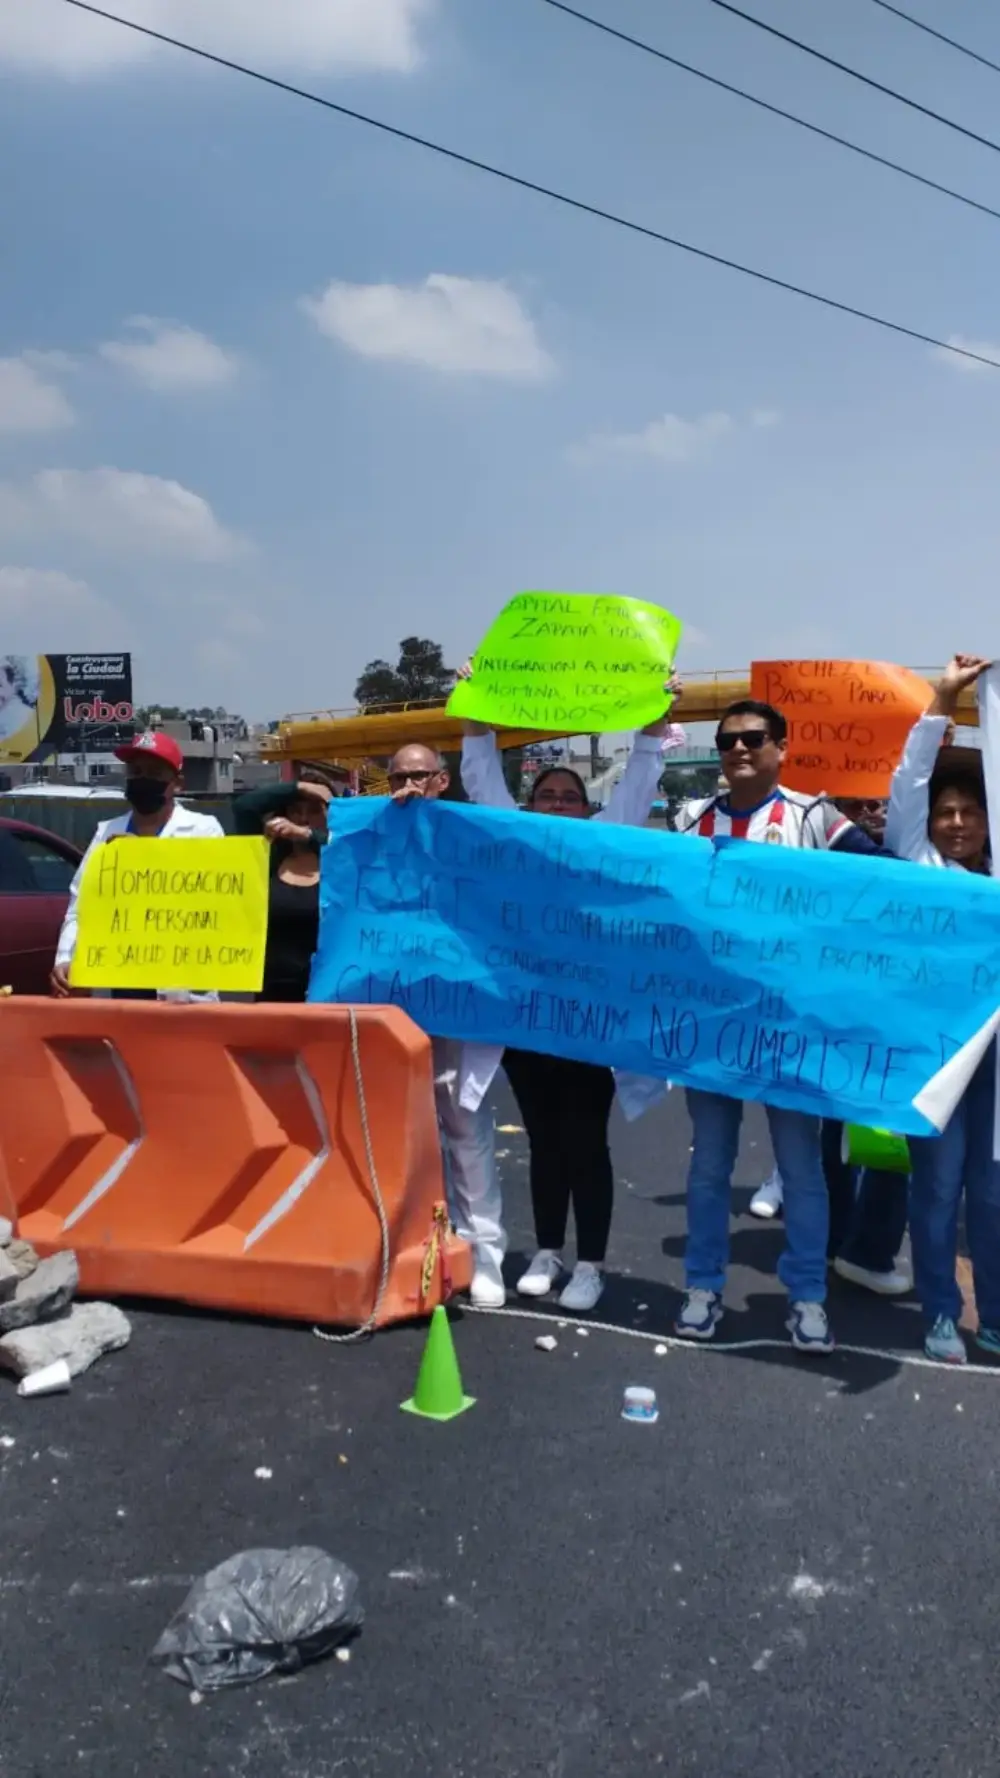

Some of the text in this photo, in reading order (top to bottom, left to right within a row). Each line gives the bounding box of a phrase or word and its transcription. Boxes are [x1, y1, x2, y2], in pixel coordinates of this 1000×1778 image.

[509, 617, 598, 639] ZAPATA
[82, 662, 123, 673] Ciudad
[478, 656, 575, 673] INTEGRACION
[584, 660, 598, 673] A
[787, 719, 875, 747] TODOS
[98, 849, 245, 900] HOMOLOGACION
[704, 853, 833, 920] EMILIANO
[843, 874, 957, 935] ZAPATA
[110, 907, 222, 934] AL PERSONAL
[86, 945, 107, 968] DE
[116, 943, 165, 967] SALUD
[172, 945, 189, 967] DE
[196, 945, 212, 965] LA
[359, 928, 464, 967] MEJORES
[501, 900, 531, 934] EL
[541, 904, 694, 953] CUMPLIMIENTO
[712, 930, 742, 957] DE
[759, 937, 801, 966] LAS
[818, 944, 946, 987] PROMESAS
[336, 965, 479, 1026] CLAUDIA
[650, 1003, 699, 1061] NO
[716, 1017, 914, 1101] CUMPLISTE
